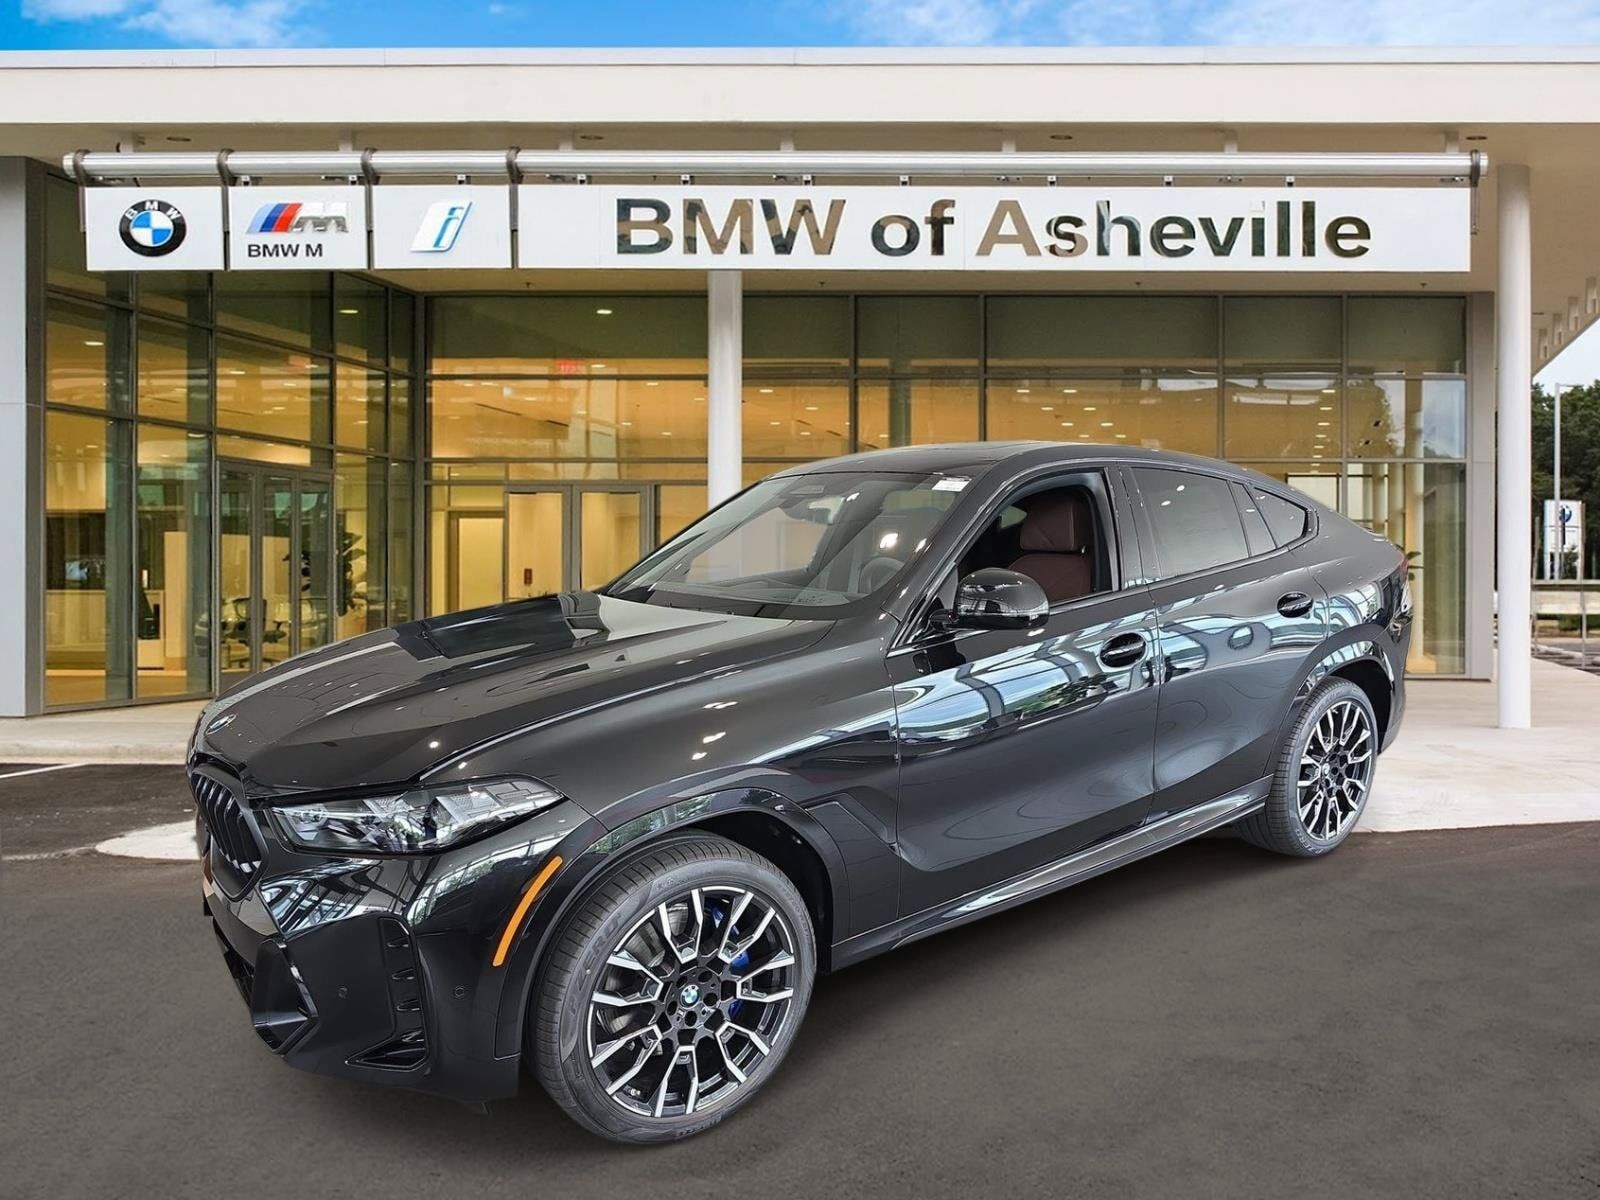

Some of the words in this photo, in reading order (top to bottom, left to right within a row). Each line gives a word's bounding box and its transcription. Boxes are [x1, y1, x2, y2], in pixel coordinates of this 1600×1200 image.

[124, 200, 182, 220] BMW
[616, 199, 846, 255] BMW
[871, 199, 955, 257] of
[976, 200, 1371, 258] Asheville
[247, 244, 300, 258] BMW
[305, 243, 324, 258] M
